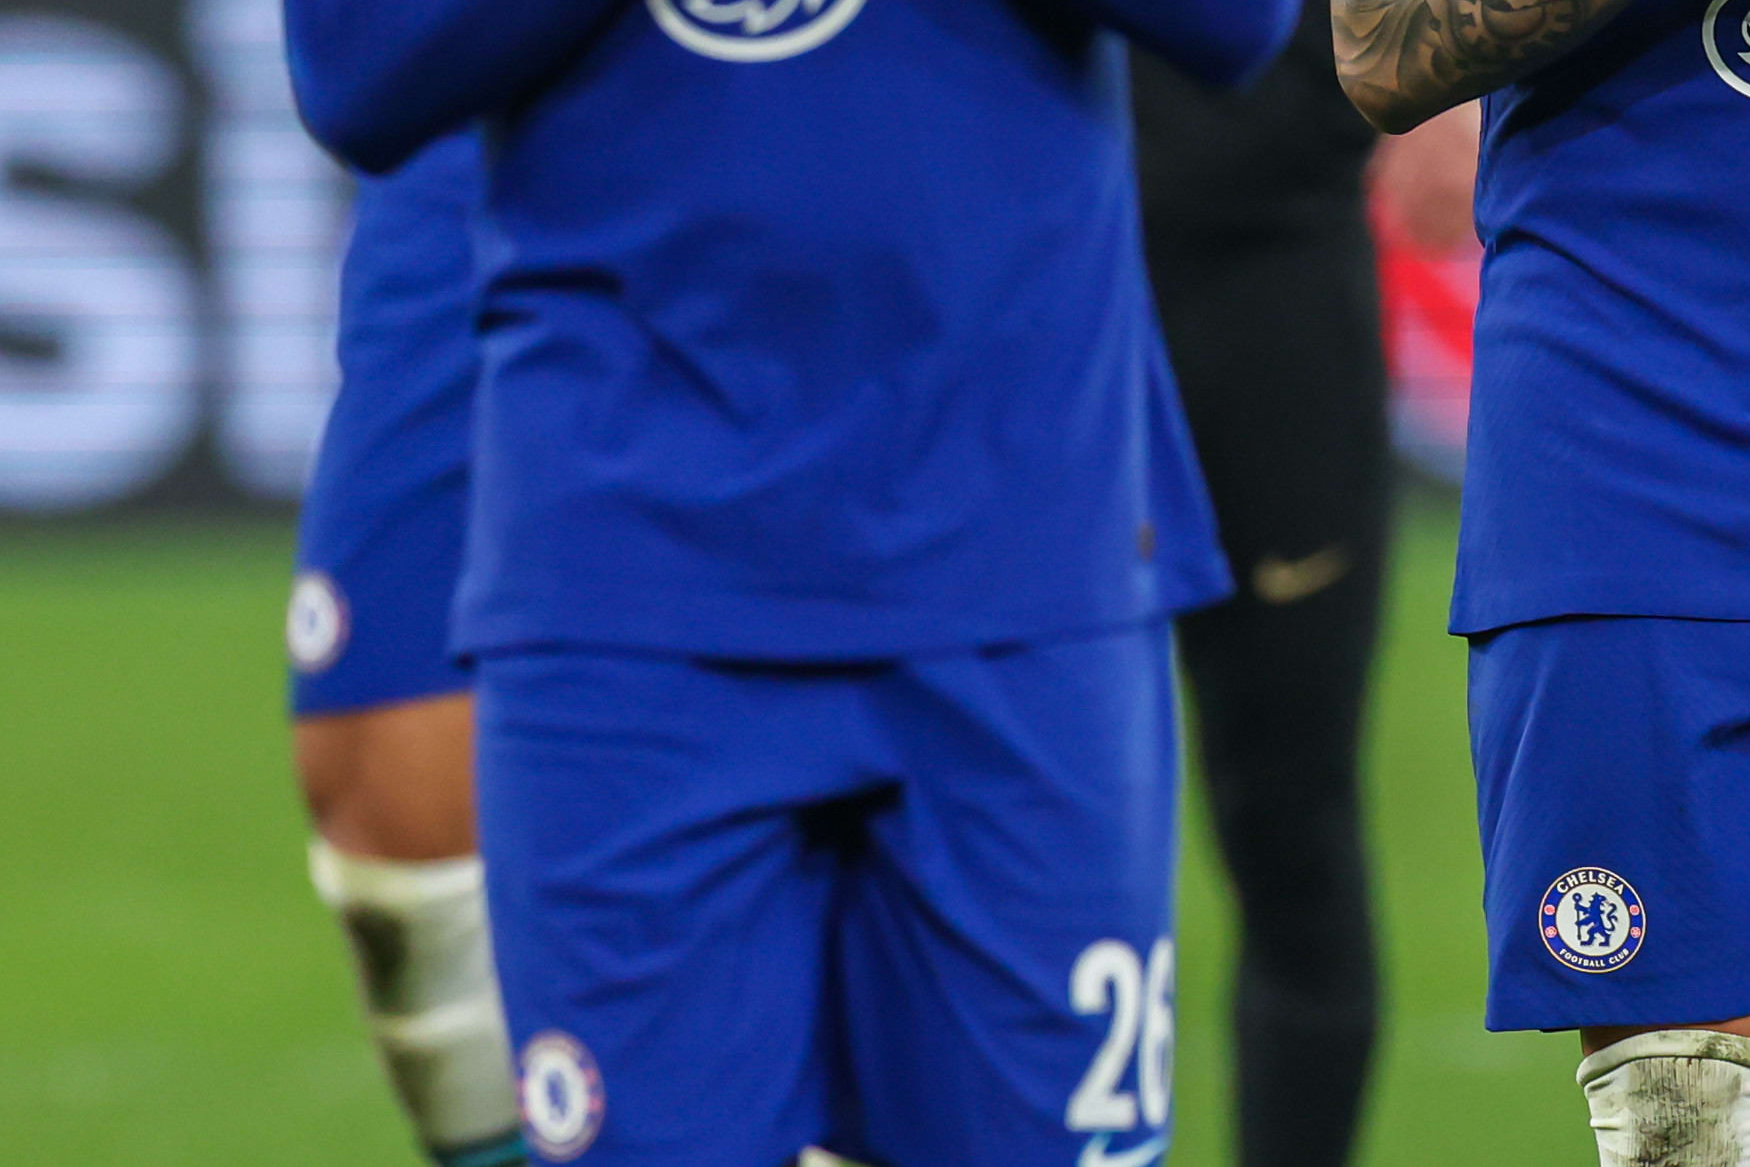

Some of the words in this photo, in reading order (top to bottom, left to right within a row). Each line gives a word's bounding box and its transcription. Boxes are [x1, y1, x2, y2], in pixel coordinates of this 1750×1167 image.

[1556, 870, 1625, 895] CHELSEA
[1559, 948, 1606, 968] FOOTBALL
[1607, 948, 1630, 966] CLUB
[1064, 938, 1177, 1133] 26
